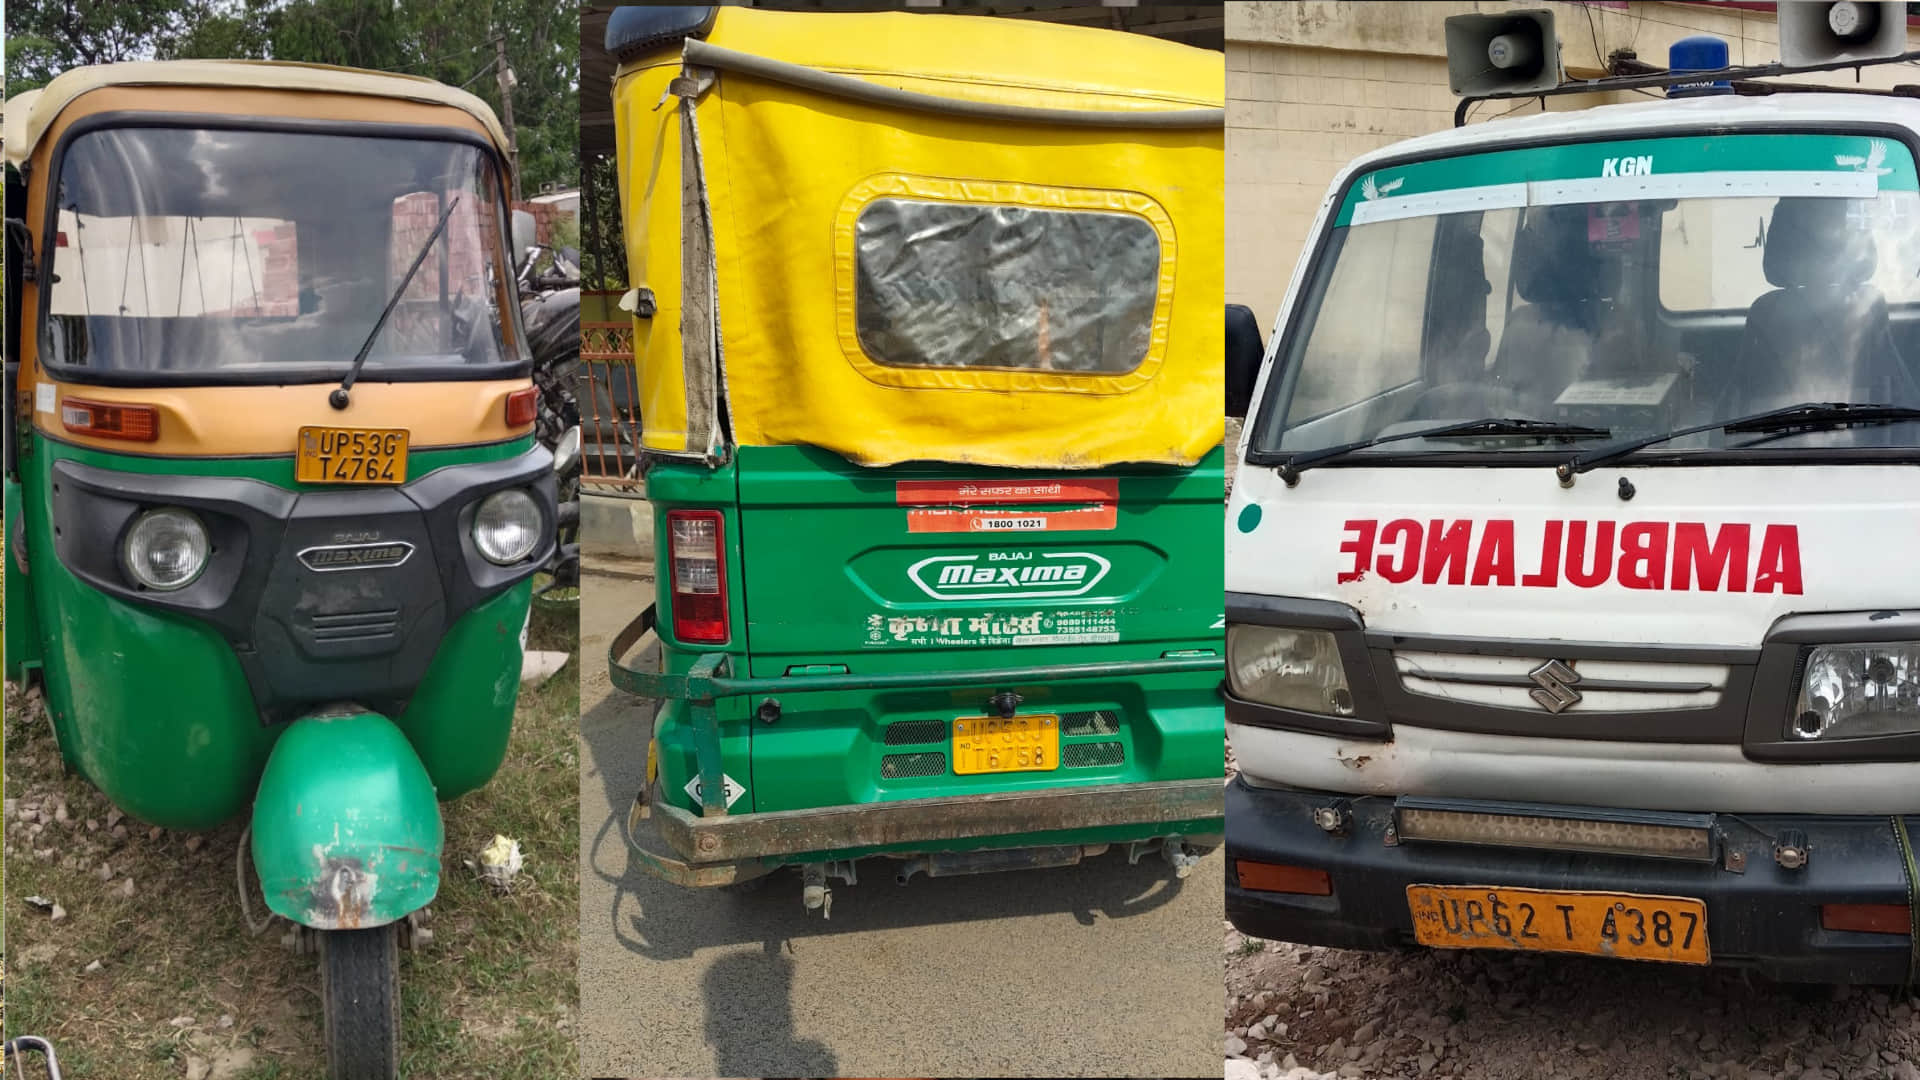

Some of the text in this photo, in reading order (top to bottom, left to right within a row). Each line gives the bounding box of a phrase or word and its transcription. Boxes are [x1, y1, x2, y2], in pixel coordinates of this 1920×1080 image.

[1602, 155, 1653, 177] KGN
[320, 431, 396, 456] UP53G
[319, 457, 394, 480] T4764
[1014, 486, 1031, 496] का
[988, 519, 1042, 529] 1800 1021
[988, 552, 1033, 561] BAJAJ
[972, 745, 1044, 768] T6758
[1556, 904, 1575, 941] T
[1601, 905, 1699, 950] 4387
